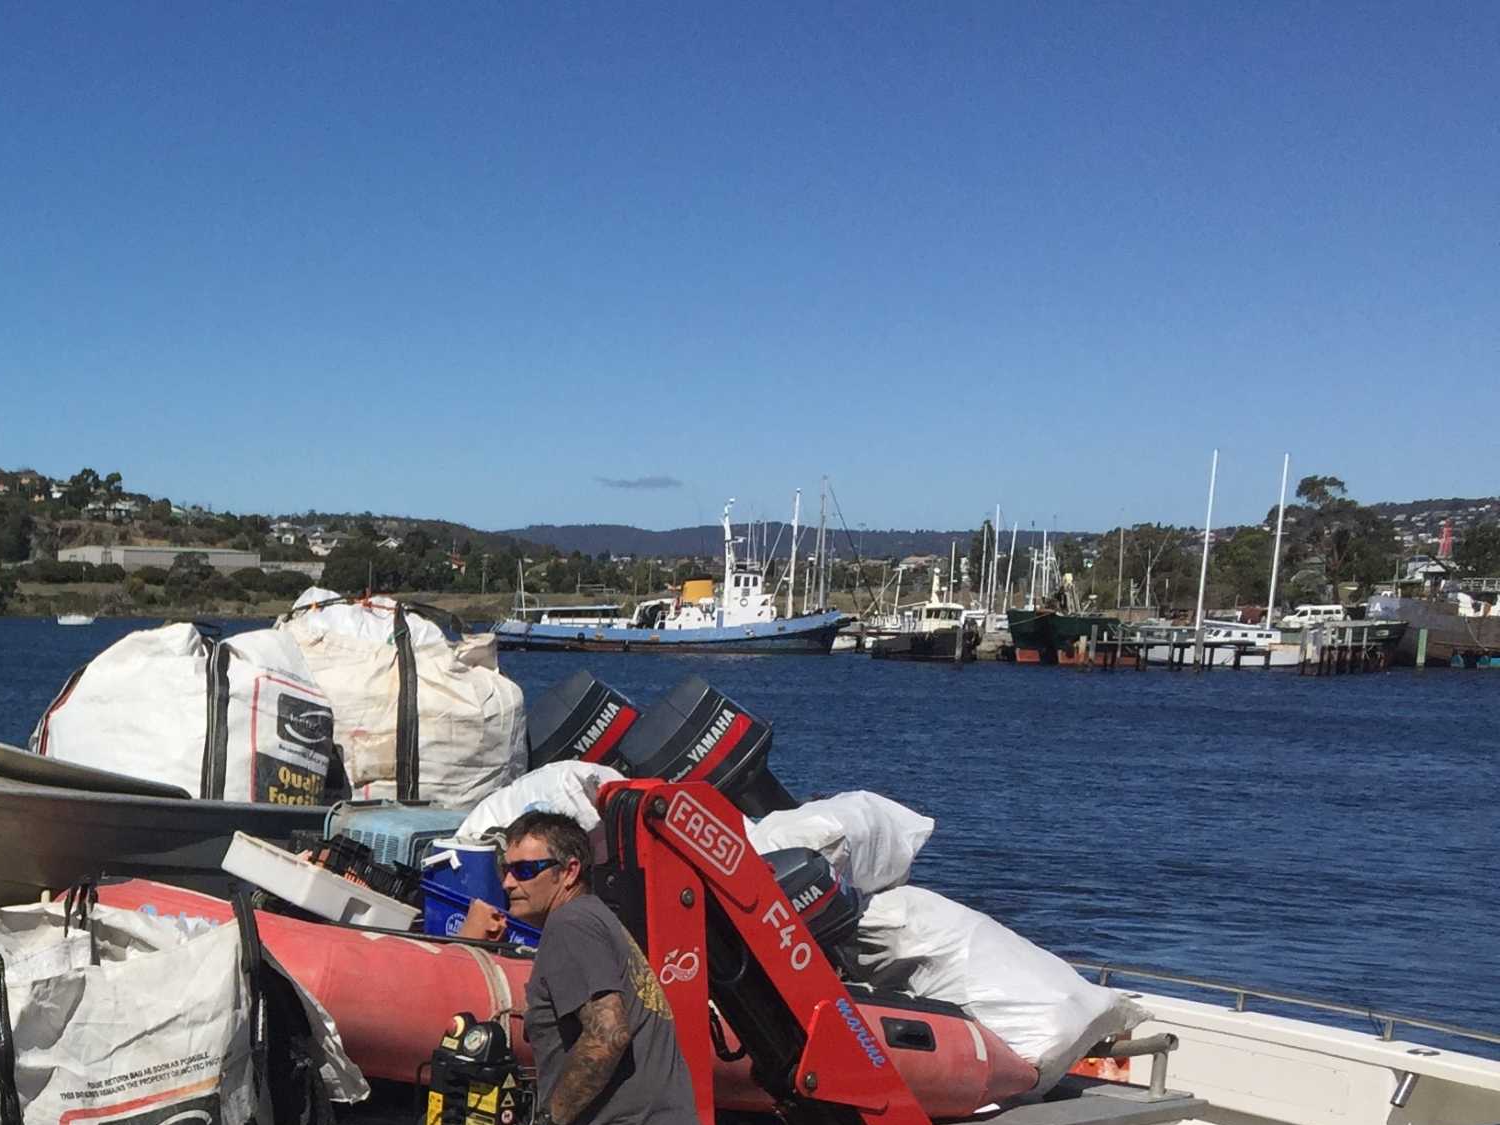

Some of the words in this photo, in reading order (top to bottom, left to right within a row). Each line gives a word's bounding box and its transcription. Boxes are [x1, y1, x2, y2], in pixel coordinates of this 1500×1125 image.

[574, 701, 620, 753] YAMAHA
[687, 708, 736, 763] YAMAHA
[278, 766, 323, 795] Quali
[672, 800, 738, 867] FASSI
[792, 884, 824, 912] AHA
[762, 900, 812, 970] F40
[835, 998, 885, 1068] marine
